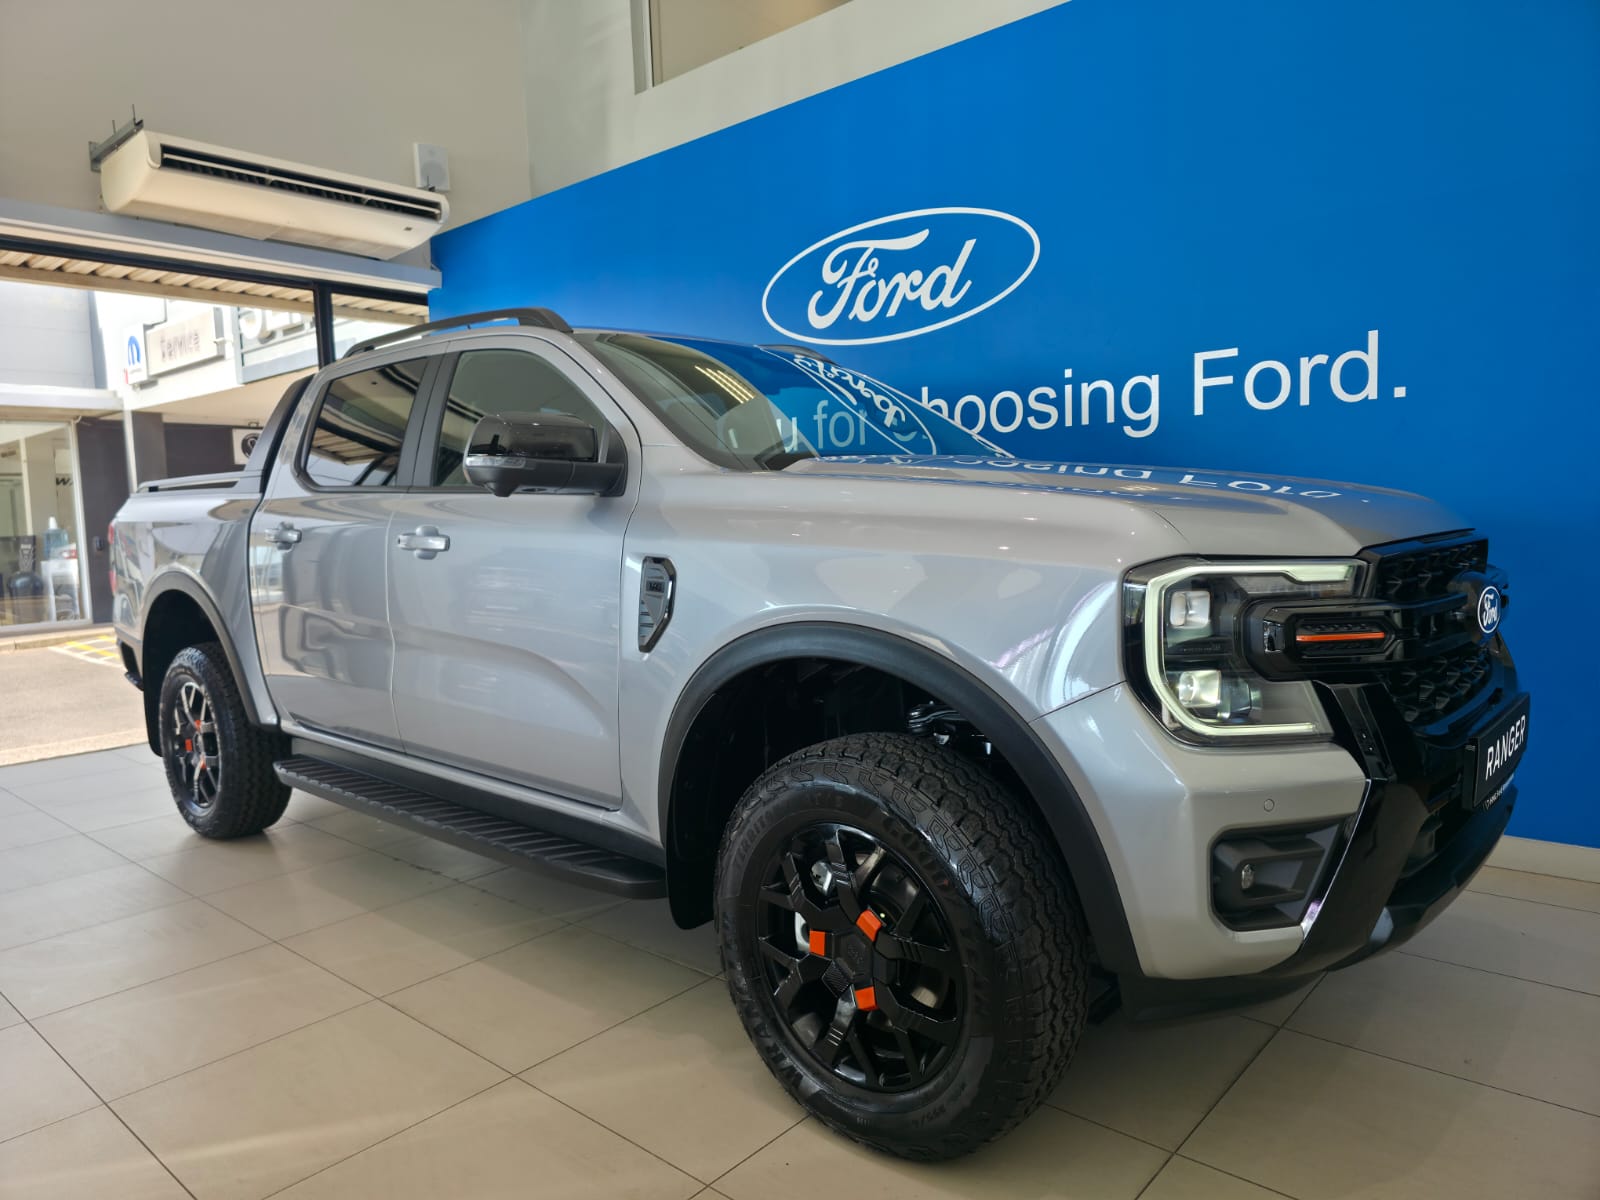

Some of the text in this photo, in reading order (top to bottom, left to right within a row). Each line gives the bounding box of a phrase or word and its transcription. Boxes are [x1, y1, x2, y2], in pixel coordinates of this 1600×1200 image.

[806, 228, 977, 329] Ford
[1192, 329, 1407, 417] Ford.
[1482, 594, 1498, 627] Ford
[1485, 715, 1527, 781] RANGER
